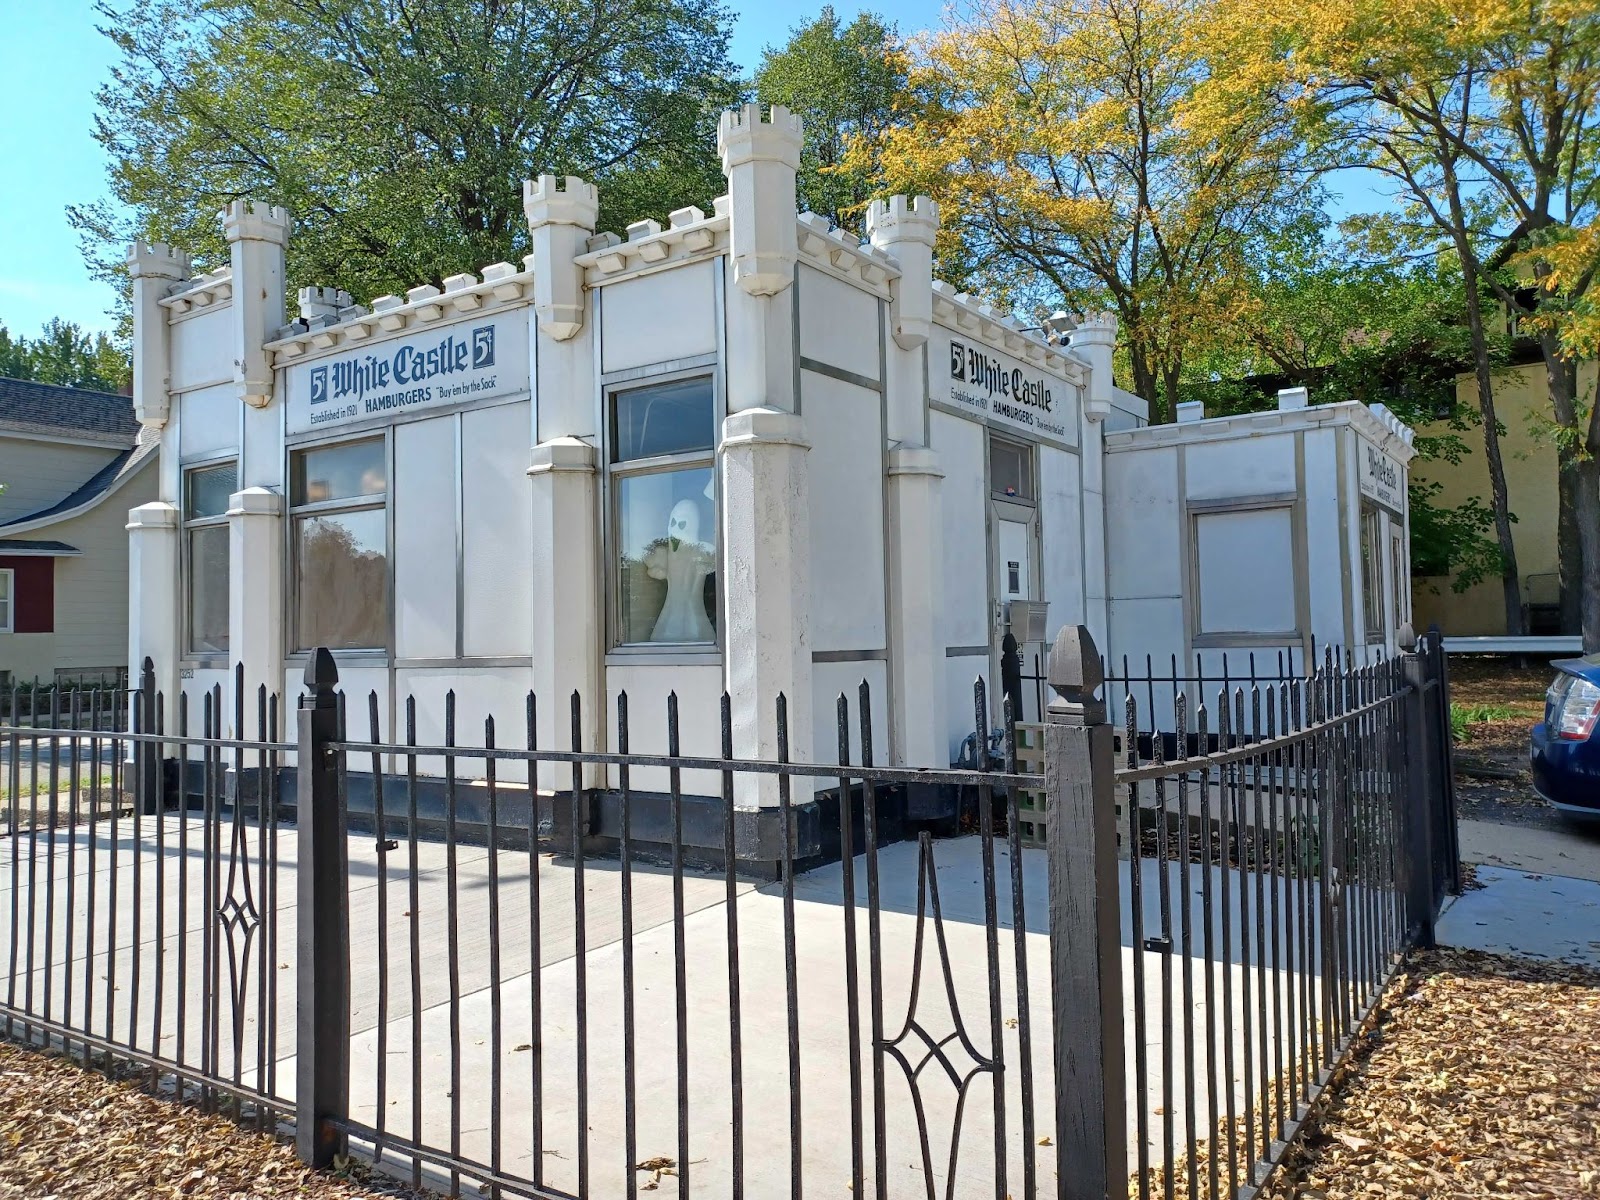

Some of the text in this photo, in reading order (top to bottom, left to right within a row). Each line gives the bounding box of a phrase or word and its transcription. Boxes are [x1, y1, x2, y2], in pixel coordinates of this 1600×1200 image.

[331, 355, 390, 402] White
[392, 335, 469, 385] Castle
[968, 347, 1010, 398] White
[1011, 368, 1052, 413] Castle
[462, 381, 470, 394] by
[470, 379, 480, 392] the
[365, 387, 431, 413] HAMBURGERS
[992, 400, 1034, 426] HAMBURGERS
[310, 404, 357, 424] Established in 1921
